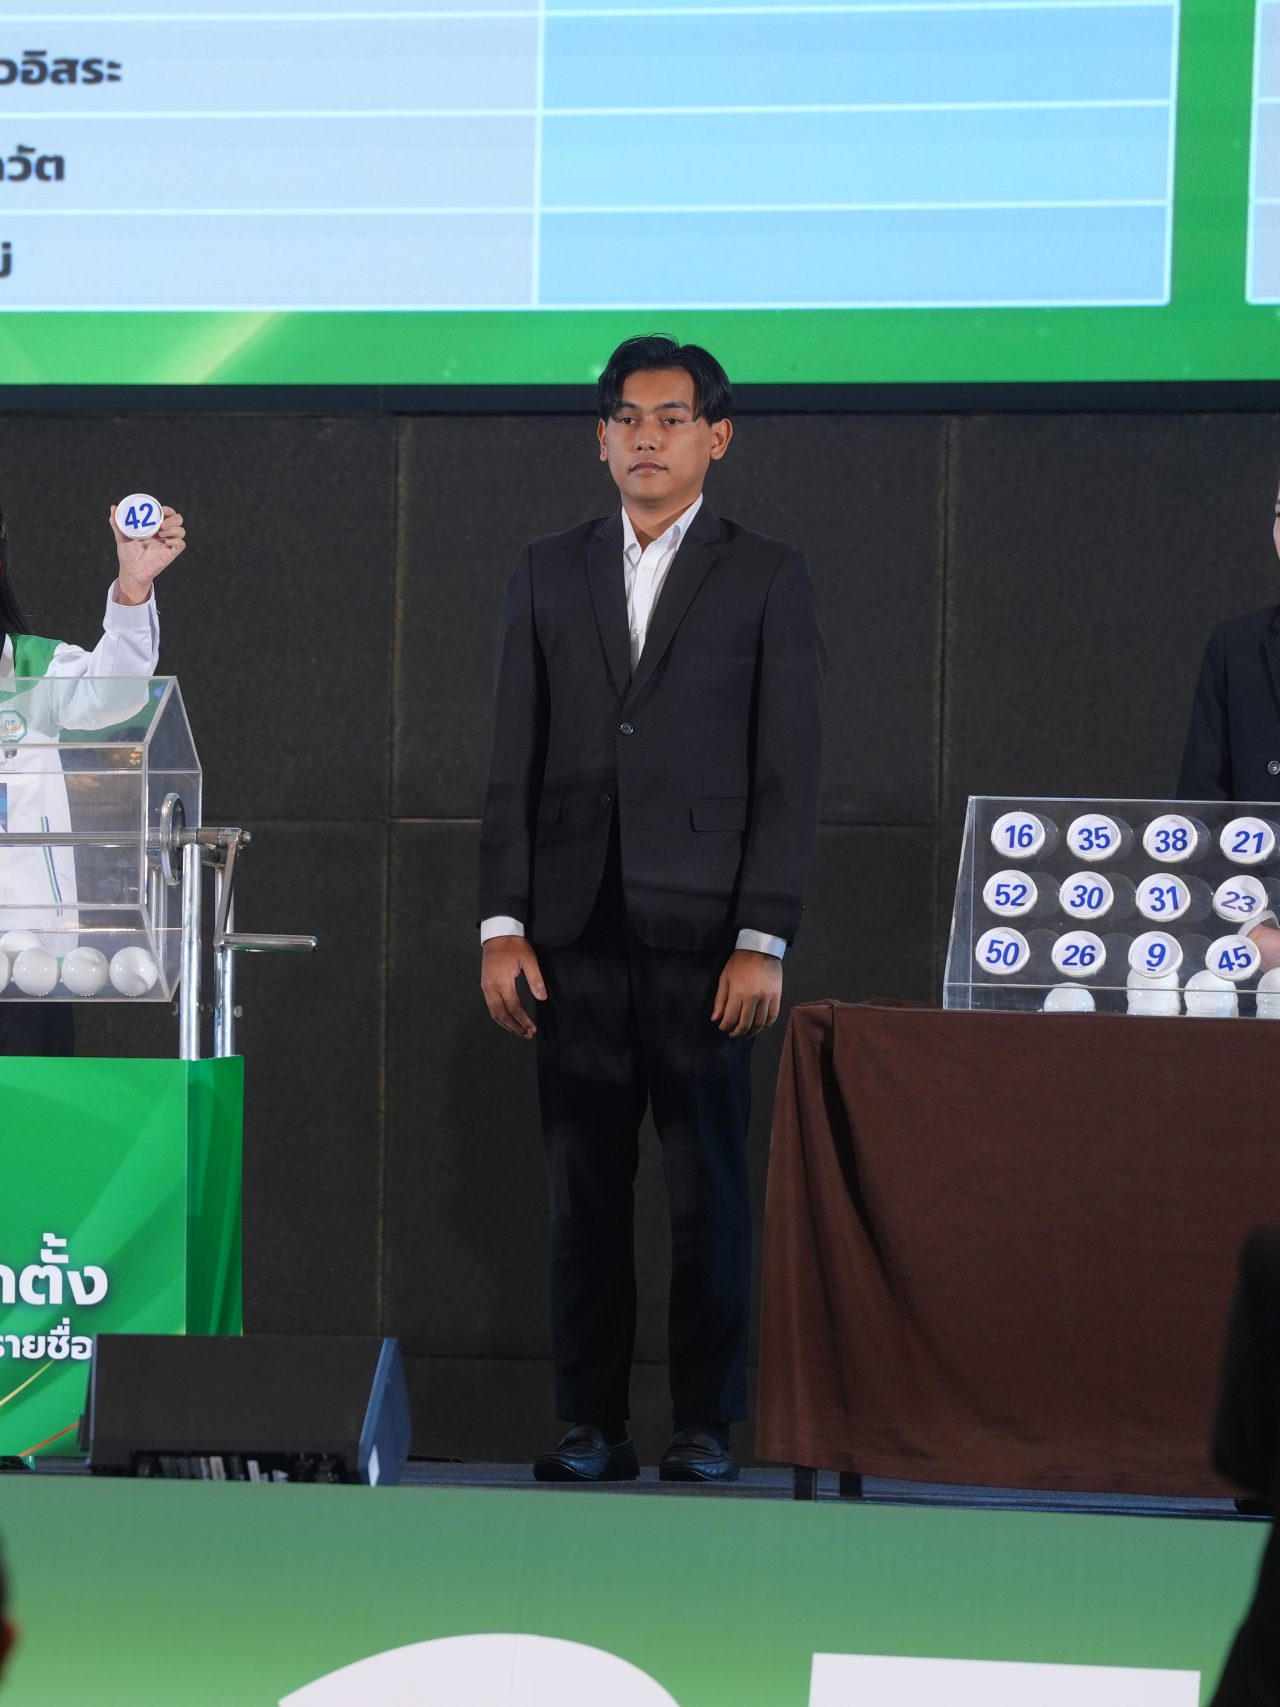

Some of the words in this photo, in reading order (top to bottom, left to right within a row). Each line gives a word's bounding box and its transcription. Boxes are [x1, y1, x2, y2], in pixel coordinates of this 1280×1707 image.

[124, 502, 156, 529] 42
[1005, 823, 1034, 848] 16
[1078, 826, 1111, 851] 35
[1155, 828, 1187, 853] 38
[1232, 830, 1264, 854] 21
[995, 884, 1028, 906] 52
[1070, 885, 1103, 909] 30
[1149, 886, 1179, 912] 31
[1221, 891, 1256, 913] 23
[985, 940, 1019, 966] 50
[1062, 944, 1096, 967] 26
[1146, 943, 1166, 971] 9
[1218, 946, 1252, 972] 45
